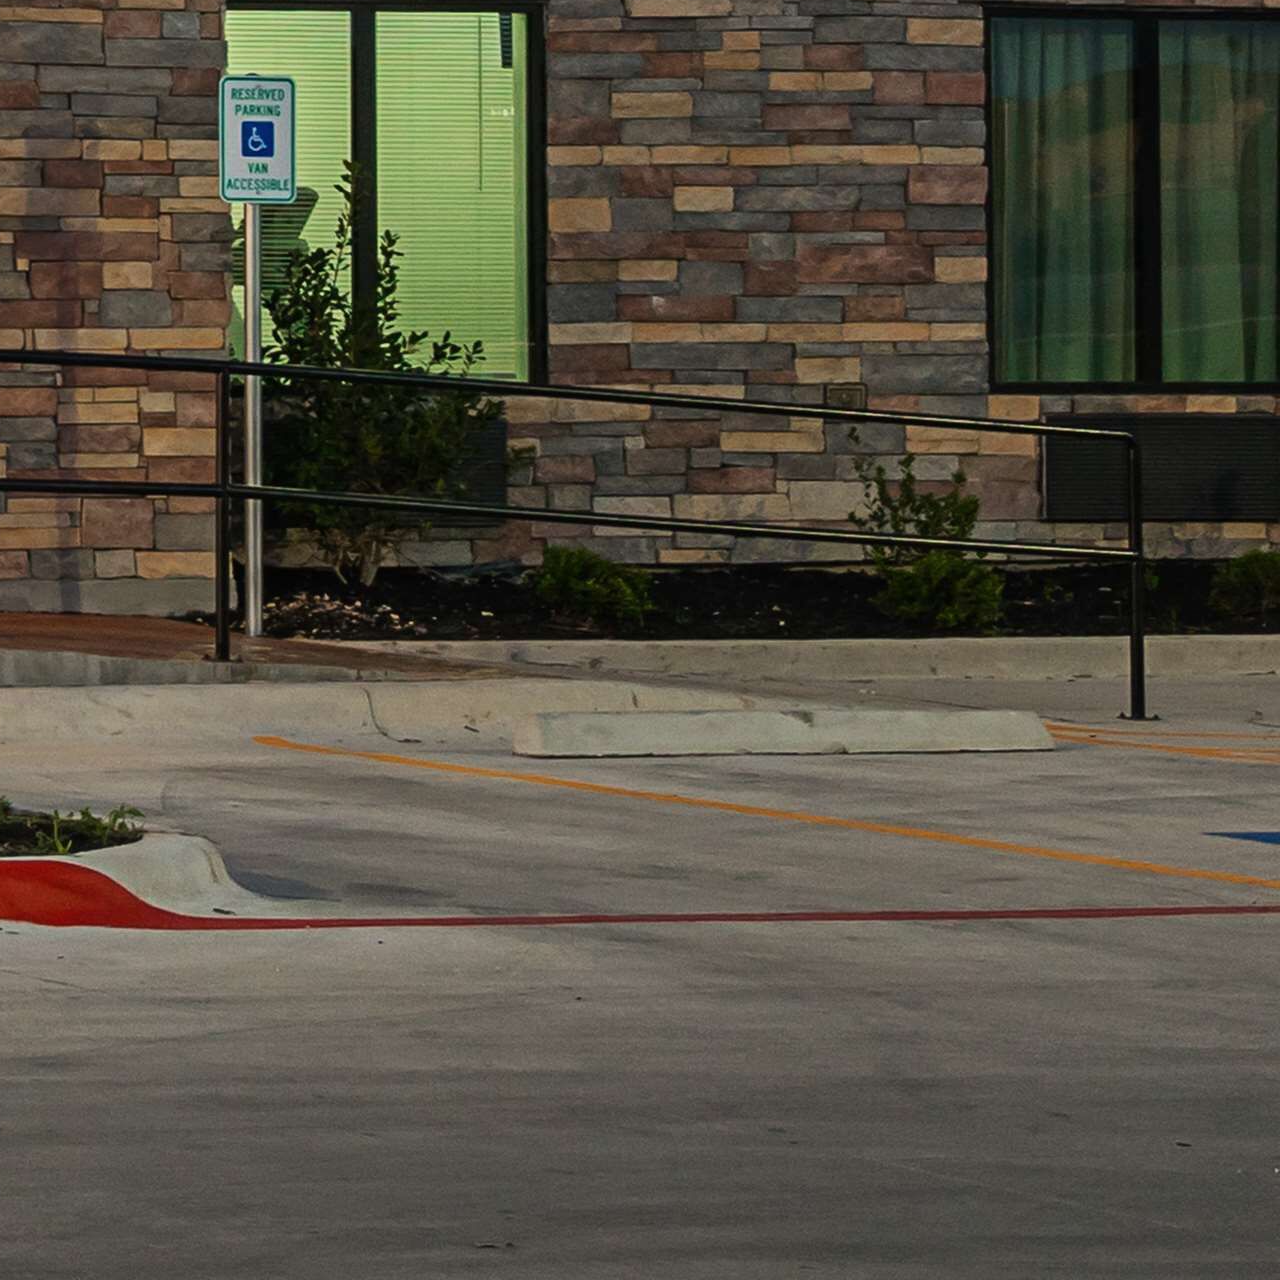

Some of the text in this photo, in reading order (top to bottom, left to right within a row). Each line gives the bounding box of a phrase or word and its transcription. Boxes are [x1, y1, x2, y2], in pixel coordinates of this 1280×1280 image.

[231, 88, 285, 101] RESERVED
[235, 105, 281, 116] PARKING
[248, 163, 269, 174] VAN
[226, 178, 290, 192] ACCESSIBLE
